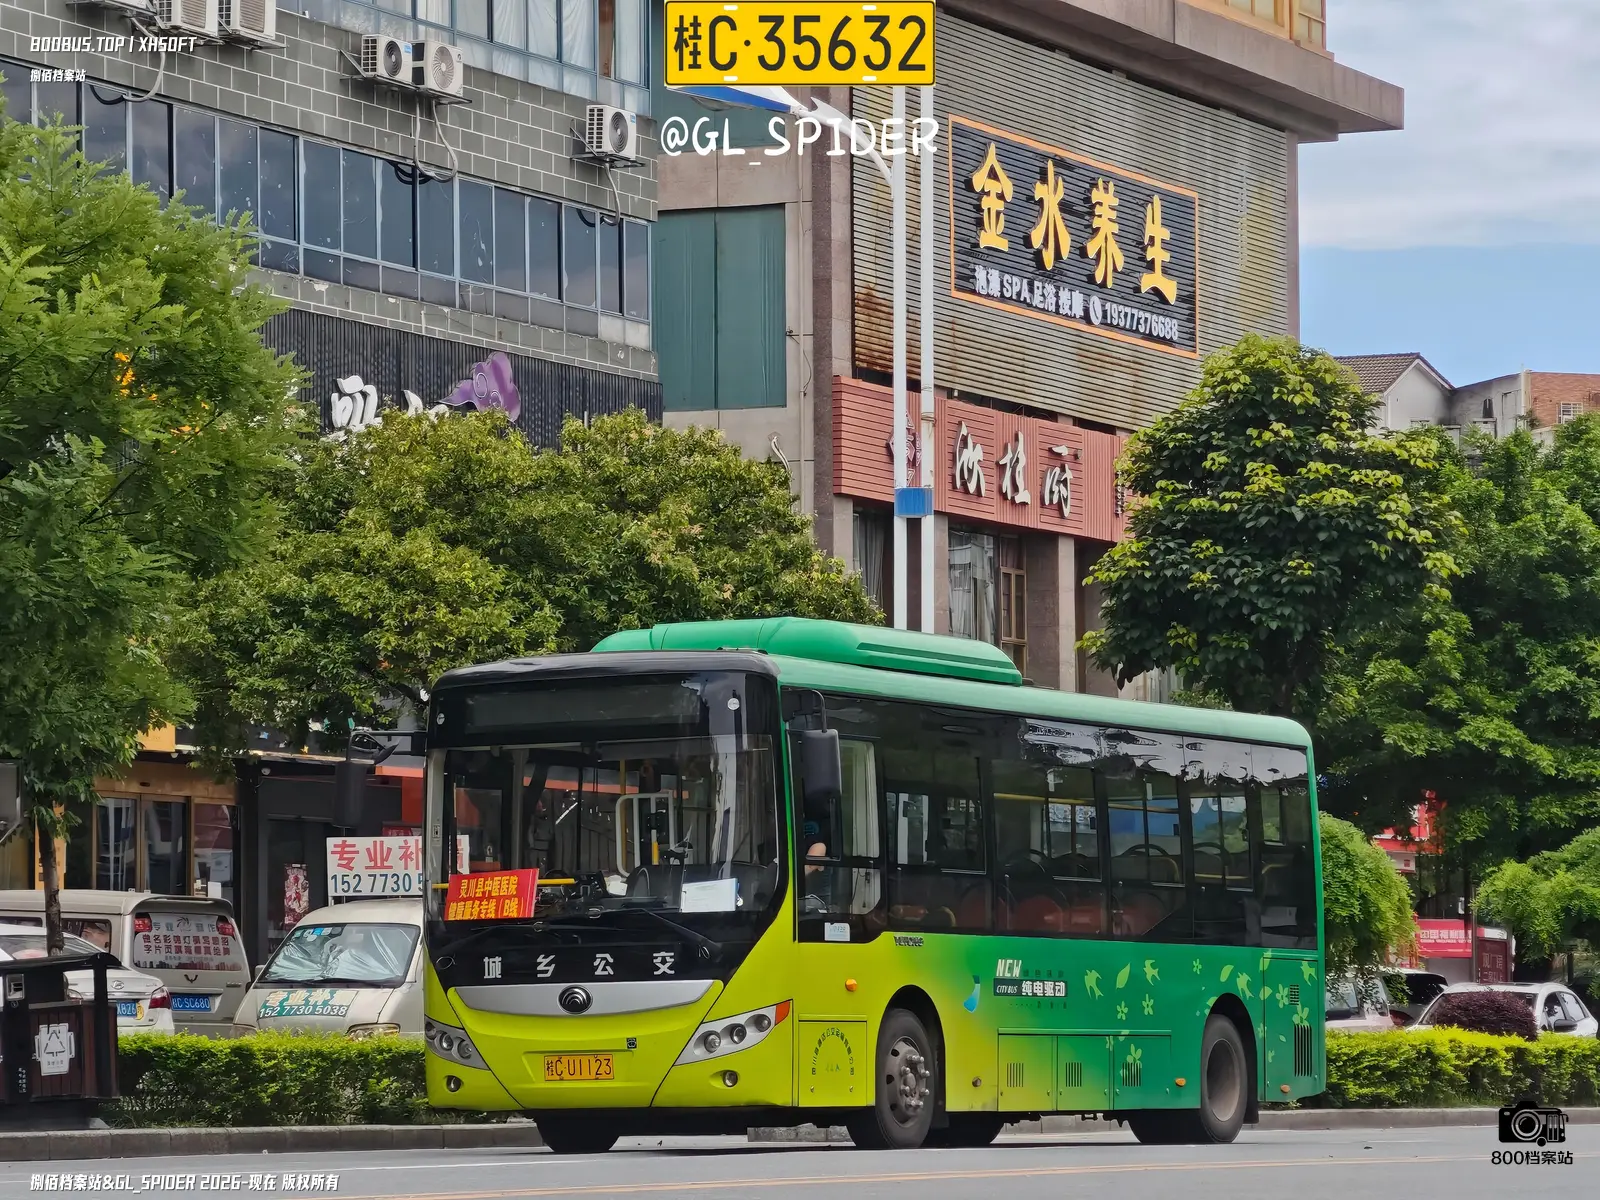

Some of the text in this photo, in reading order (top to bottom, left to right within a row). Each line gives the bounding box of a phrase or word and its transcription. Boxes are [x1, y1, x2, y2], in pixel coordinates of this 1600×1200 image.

[972, 142, 1177, 305] 金水养生
[1003, 273, 1031, 303] SPA
[1106, 302, 1178, 340] 19377376688
[331, 874, 362, 893] 152
[368, 873, 412, 893] 7730
[459, 876, 518, 898] 灵川县中医医院
[483, 951, 675, 979] 城乡公交
[996, 959, 1022, 977] NEW
[1022, 981, 1066, 997] 纯电驱动
[260, 1005, 347, 1018] 152 7730 5038
